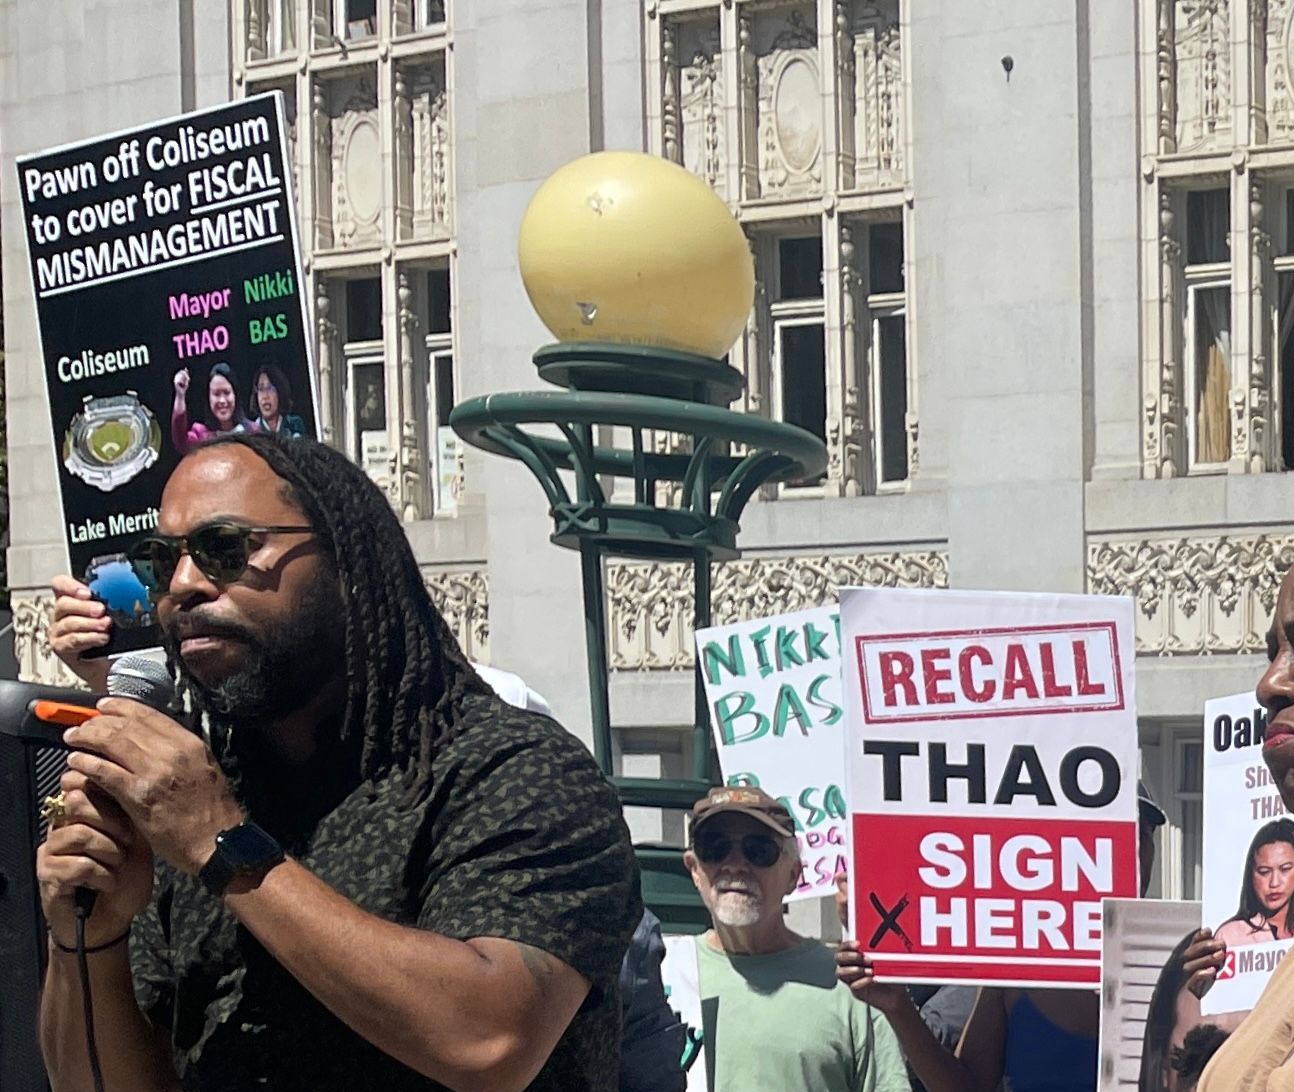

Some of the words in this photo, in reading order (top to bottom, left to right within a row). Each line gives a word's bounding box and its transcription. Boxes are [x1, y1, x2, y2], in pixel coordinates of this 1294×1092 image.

[24, 162, 97, 203] Pawn
[103, 139, 140, 183] off
[146, 115, 270, 171] Coliseum
[31, 213, 61, 246] to
[67, 192, 138, 236] cover
[142, 181, 182, 218] for
[188, 153, 281, 206] FISCAL
[37, 200, 281, 290] MISMANAGEMENT
[169, 287, 231, 320] Mayor
[243, 268, 294, 304] Nikki
[173, 325, 230, 359] THAO
[249, 314, 289, 344] BAS
[57, 344, 150, 383] Coliseum
[69, 517, 106, 543] Lake
[879, 640, 1105, 707] RECALL
[714, 673, 843, 746] BAS
[863, 740, 1121, 808] THAO
[1250, 797, 1288, 820] THA
[918, 832, 1113, 892] SIGN
